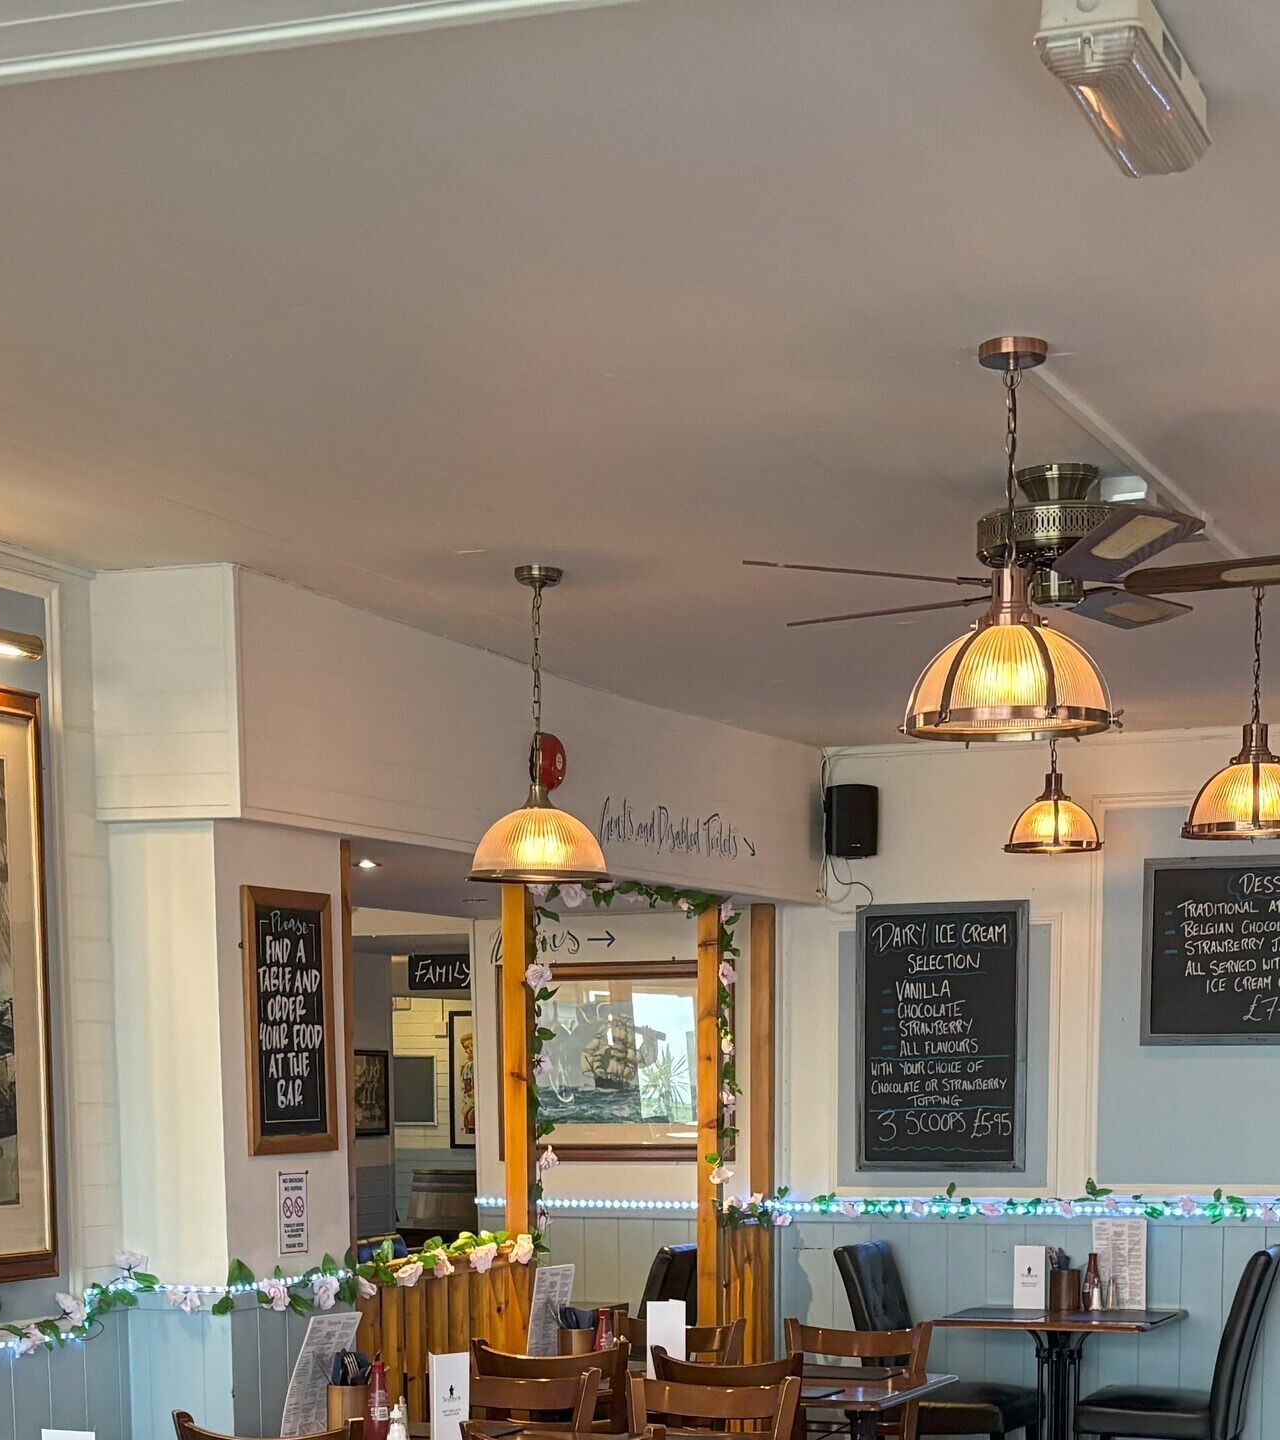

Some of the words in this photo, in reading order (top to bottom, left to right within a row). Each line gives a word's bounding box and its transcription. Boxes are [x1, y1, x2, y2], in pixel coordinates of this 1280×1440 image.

[1177, 900, 1259, 918] TRADITIONAL
[270, 910, 309, 935] Please
[1181, 921, 1234, 937] BELGIAN
[872, 923, 926, 952] DAIRY
[936, 924, 955, 943] ICE
[962, 923, 1007, 944] CREAM
[1185, 937, 1265, 956] STRAWBERRY
[266, 936, 290, 964] FIND
[296, 938, 306, 964] A
[415, 959, 471, 987] FAMILY
[908, 953, 980, 974] SELECTION
[1185, 960, 1205, 977] ALL
[1210, 959, 1256, 975] SERVED
[257, 966, 292, 993] TABLE
[294, 973, 320, 993] AND
[1206, 978, 1226, 994] ICE
[1234, 976, 1271, 992] CREAM
[896, 980, 951, 1001] VANILLA
[267, 995, 307, 1023] ORDER
[898, 1000, 966, 1018] CHOCOLATE
[259, 1022, 289, 1050] YOUR
[293, 1024, 323, 1050] FOOD
[899, 1018, 974, 1037] STRAWBERRY
[900, 1040, 920, 1056] ALL
[925, 1038, 978, 1054] FLAVOURS
[268, 1052, 283, 1079] AT
[287, 1052, 311, 1078] THE
[871, 1062, 893, 1076] WITH
[900, 1061, 925, 1075] YOUR
[927, 1061, 961, 1075] CHOICE
[967, 1060, 984, 1073] OF
[871, 1079, 919, 1095] CHOCOLATE
[925, 1079, 939, 1092] OR
[943, 1078, 1007, 1092] STRAWBERRY
[908, 1095, 963, 1107] TOPPING
[877, 1110, 897, 1142] 3
[905, 1111, 966, 1135] SCOOPS
